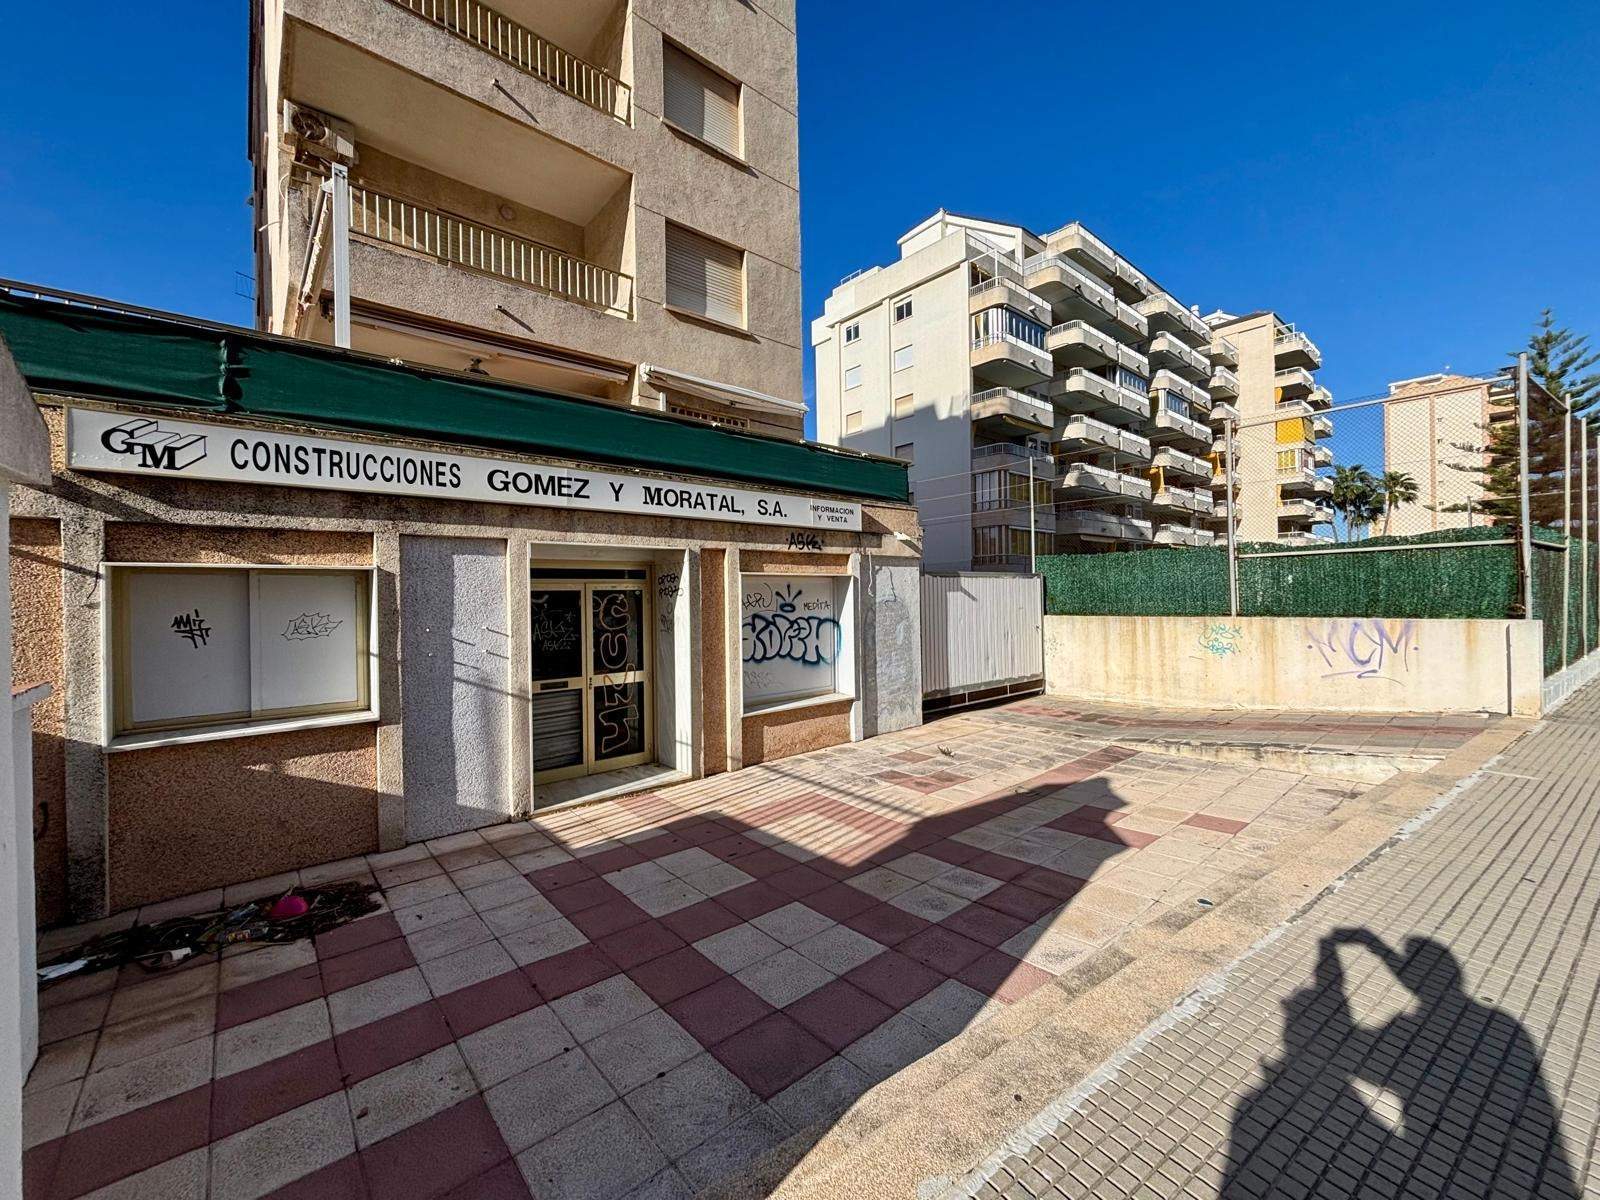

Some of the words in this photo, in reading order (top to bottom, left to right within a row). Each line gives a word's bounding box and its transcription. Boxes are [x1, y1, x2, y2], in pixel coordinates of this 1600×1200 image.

[230, 438, 461, 489] CONSTRUCCIONES
[487, 469, 591, 499] GOMEZ
[609, 482, 624, 502] Y
[643, 486, 746, 517] MORATAL,
[757, 499, 788, 518] S.A.
[810, 504, 854, 516] INFORMACION
[827, 515, 848, 523] VENTA
